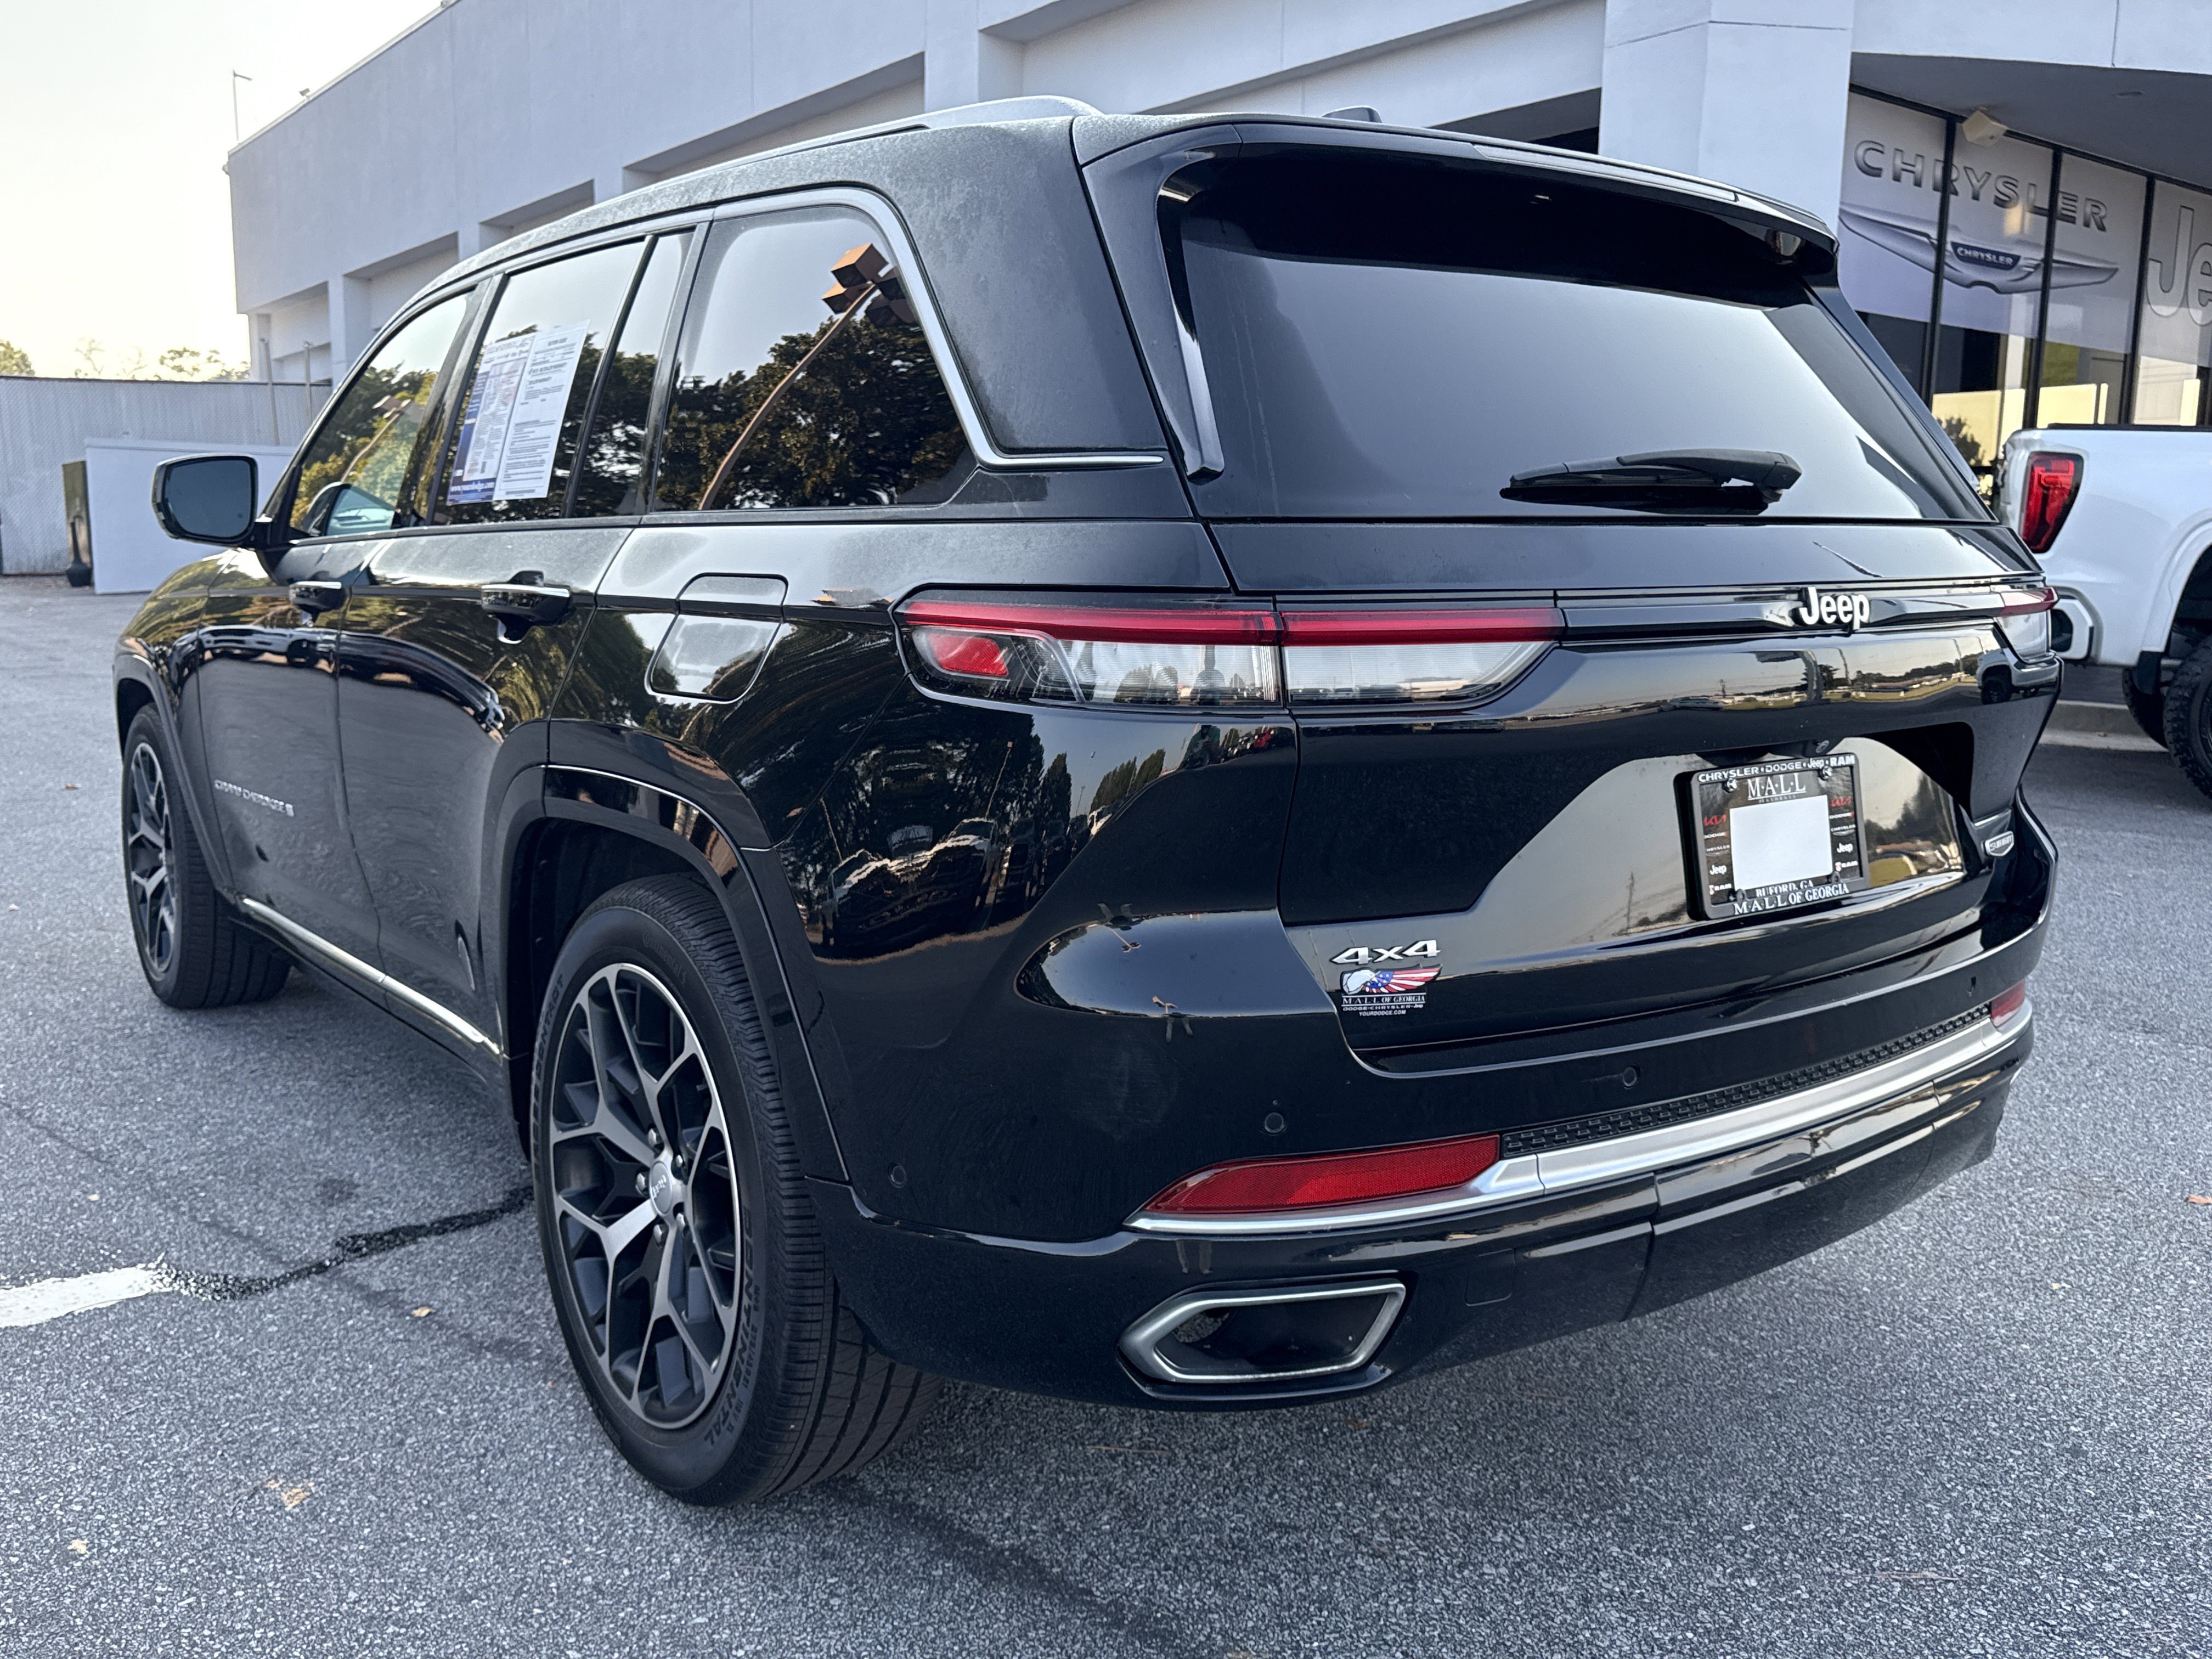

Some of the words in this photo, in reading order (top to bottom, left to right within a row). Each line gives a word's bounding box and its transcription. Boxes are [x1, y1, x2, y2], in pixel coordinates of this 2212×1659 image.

[1854, 140, 2108, 233] CHRYSLER
[1957, 247, 2013, 266] CHRYSLER
[1799, 586, 1870, 630] Jeep
[1698, 768, 1759, 782] CHRYSLER
[1765, 761, 1802, 773] DODGE
[1807, 758, 1824, 768] Jeep
[1830, 755, 1855, 766] RAM
[1837, 843, 1853, 853] Jeep
[1709, 865, 1727, 875] Jeep
[1788, 891, 1803, 905] OF
[1804, 883, 1849, 902] GEORGIA
[1800, 879, 1814, 889] GA
